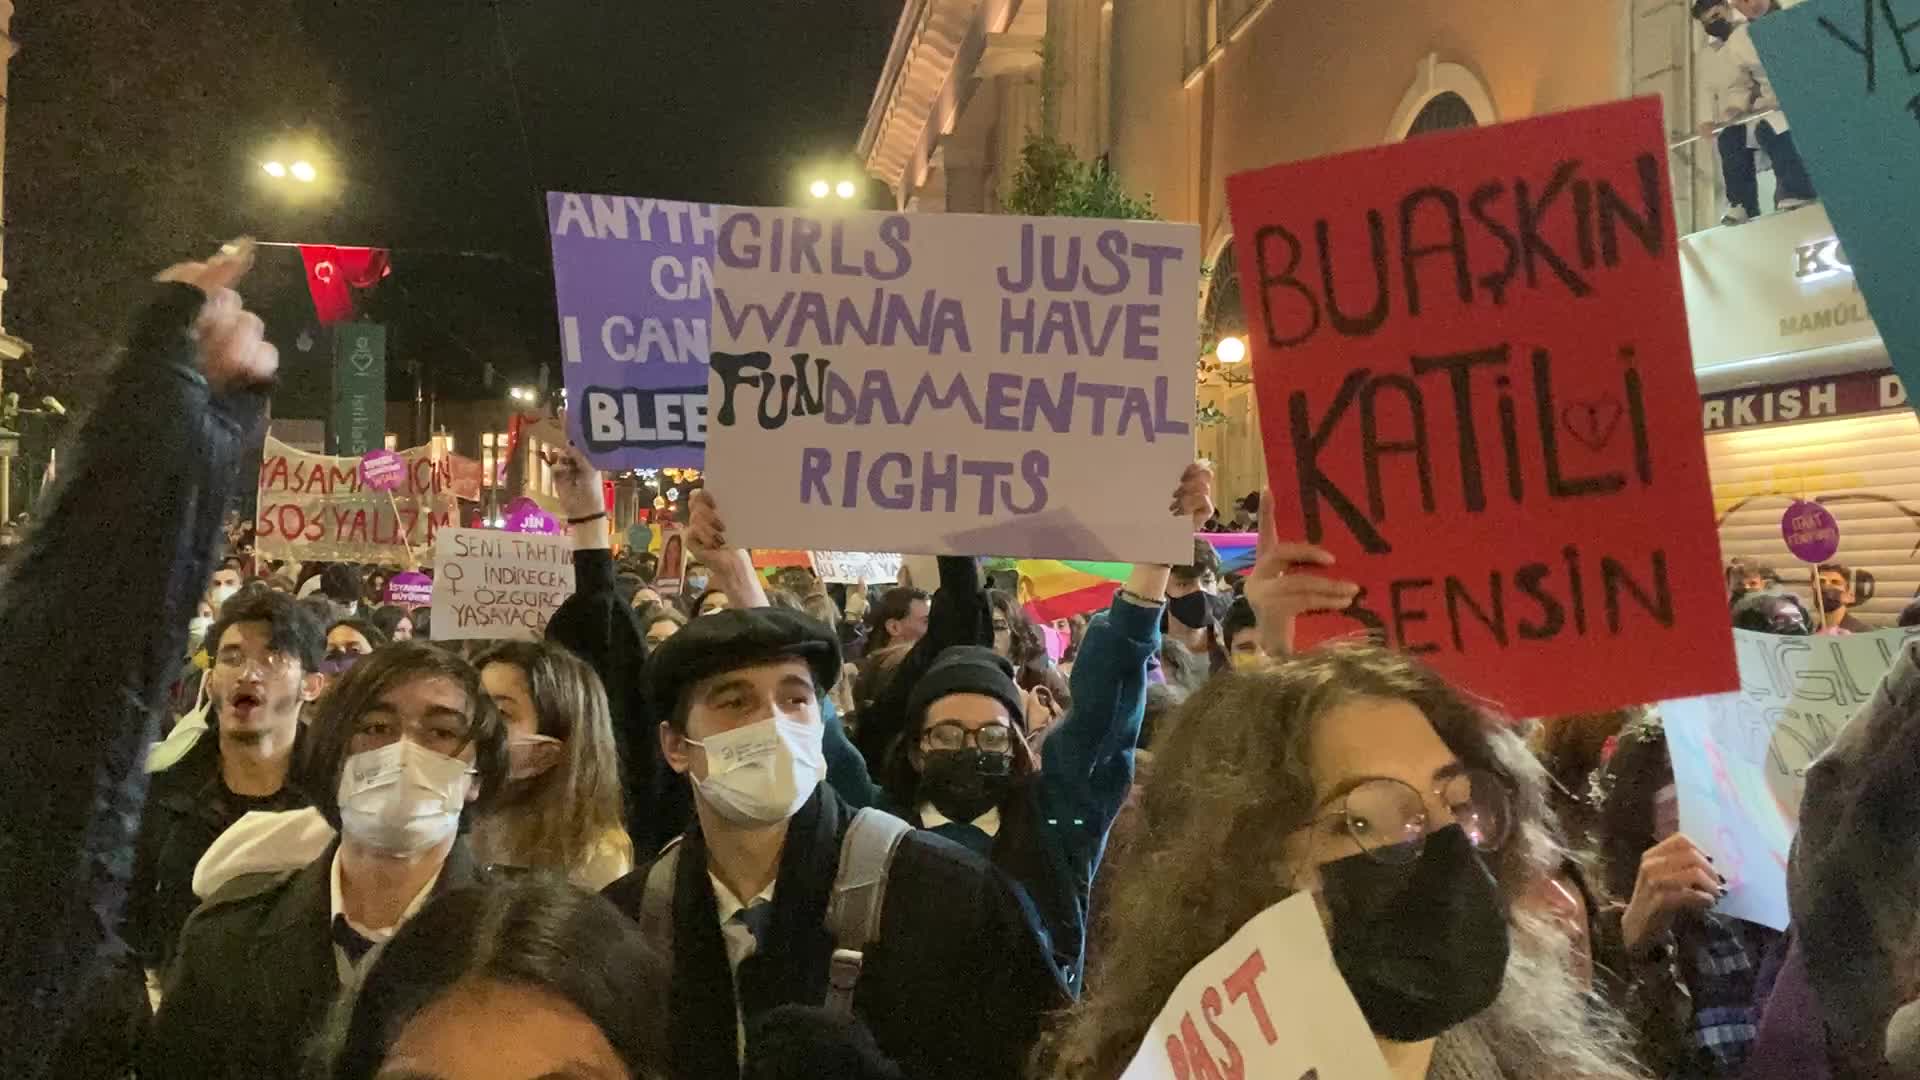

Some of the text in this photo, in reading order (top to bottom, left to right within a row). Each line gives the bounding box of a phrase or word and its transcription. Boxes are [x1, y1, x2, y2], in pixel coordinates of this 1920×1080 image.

[717, 212, 1184, 296] GIRLS JUST
[564, 315, 710, 364] I CAN
[714, 286, 1160, 360] WANNA HAVE
[588, 392, 709, 443] BLEE
[709, 350, 1189, 443] FUNDAMENTAL
[1704, 384, 1837, 429] RKISH
[801, 447, 1051, 516] RIGHTS
